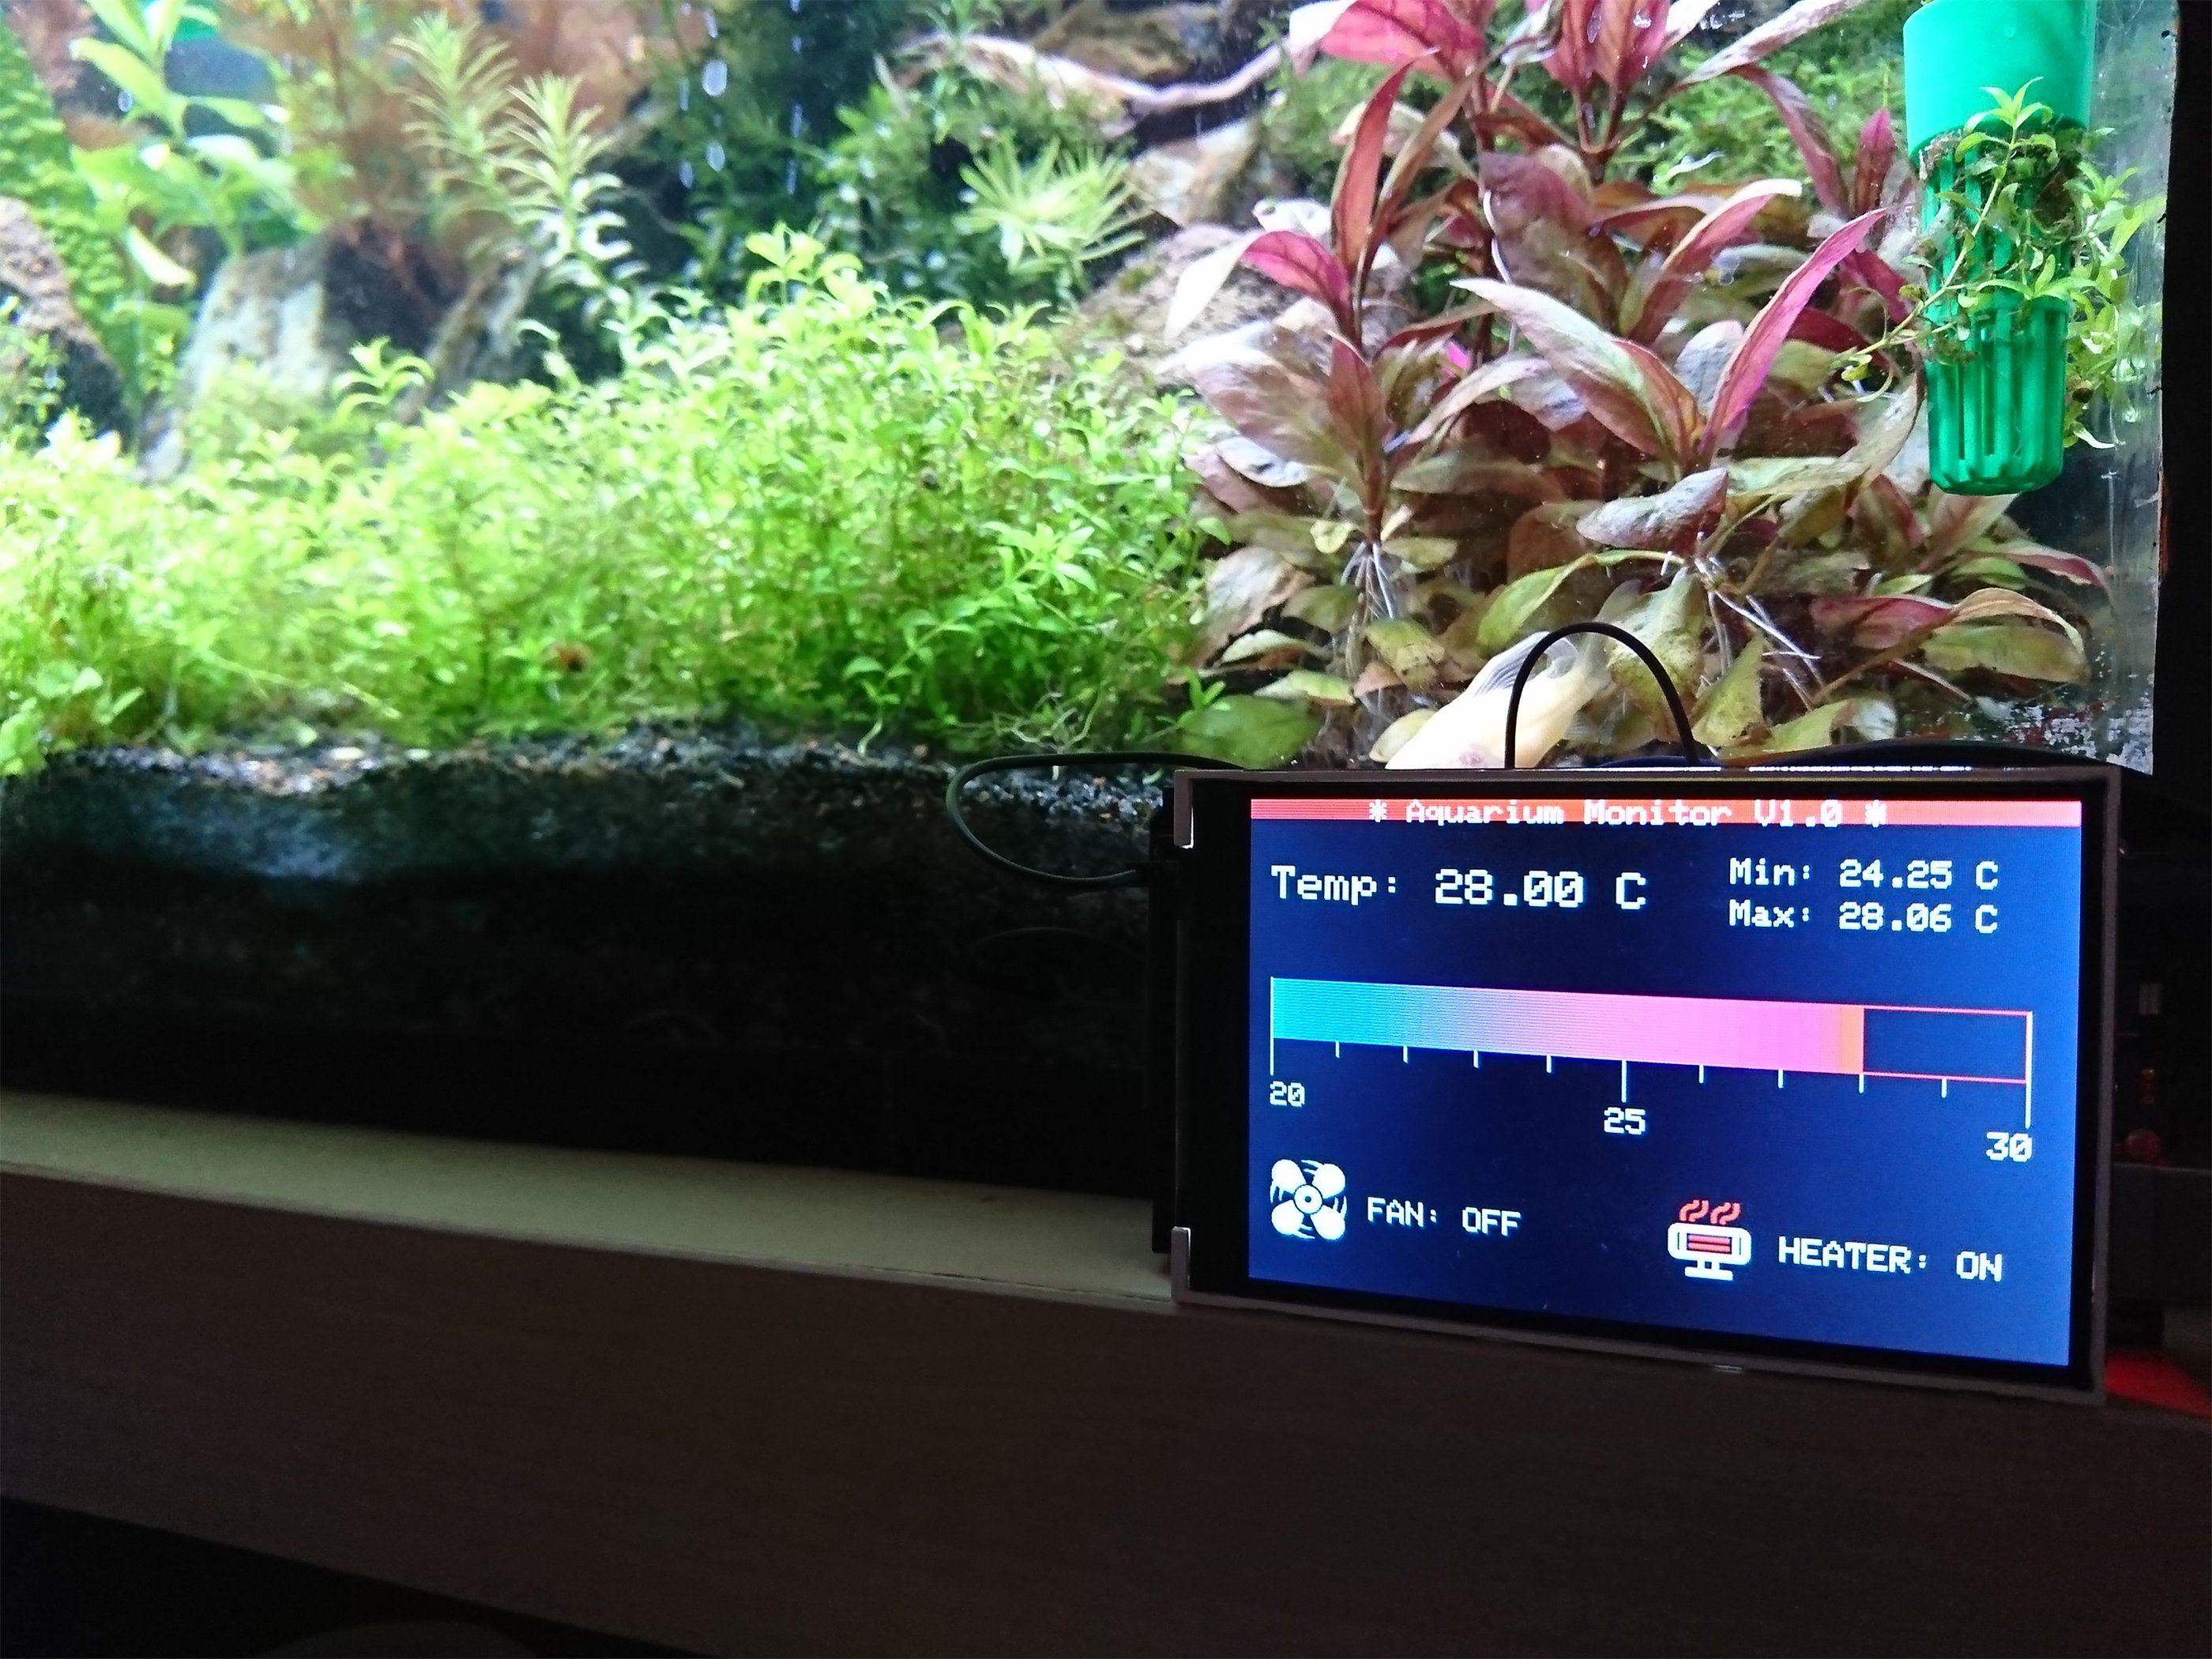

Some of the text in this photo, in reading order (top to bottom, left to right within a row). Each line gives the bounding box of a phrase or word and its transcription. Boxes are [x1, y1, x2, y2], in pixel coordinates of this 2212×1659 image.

[1405, 799, 1844, 828] Aquarium Monitor V1.0
[1270, 864, 1648, 910] Temp: 28.00 C
[1729, 857, 1999, 891] Min: 24.25 C
[1729, 898, 1999, 935] Max: 28.06 C
[1269, 1080, 1306, 1108] 20
[1602, 1106, 1647, 1136] 25
[1984, 1131, 2033, 1164] 30
[1367, 1196, 1522, 1237] FAN: OFF
[1778, 1235, 2003, 1283] HEATER: ON
